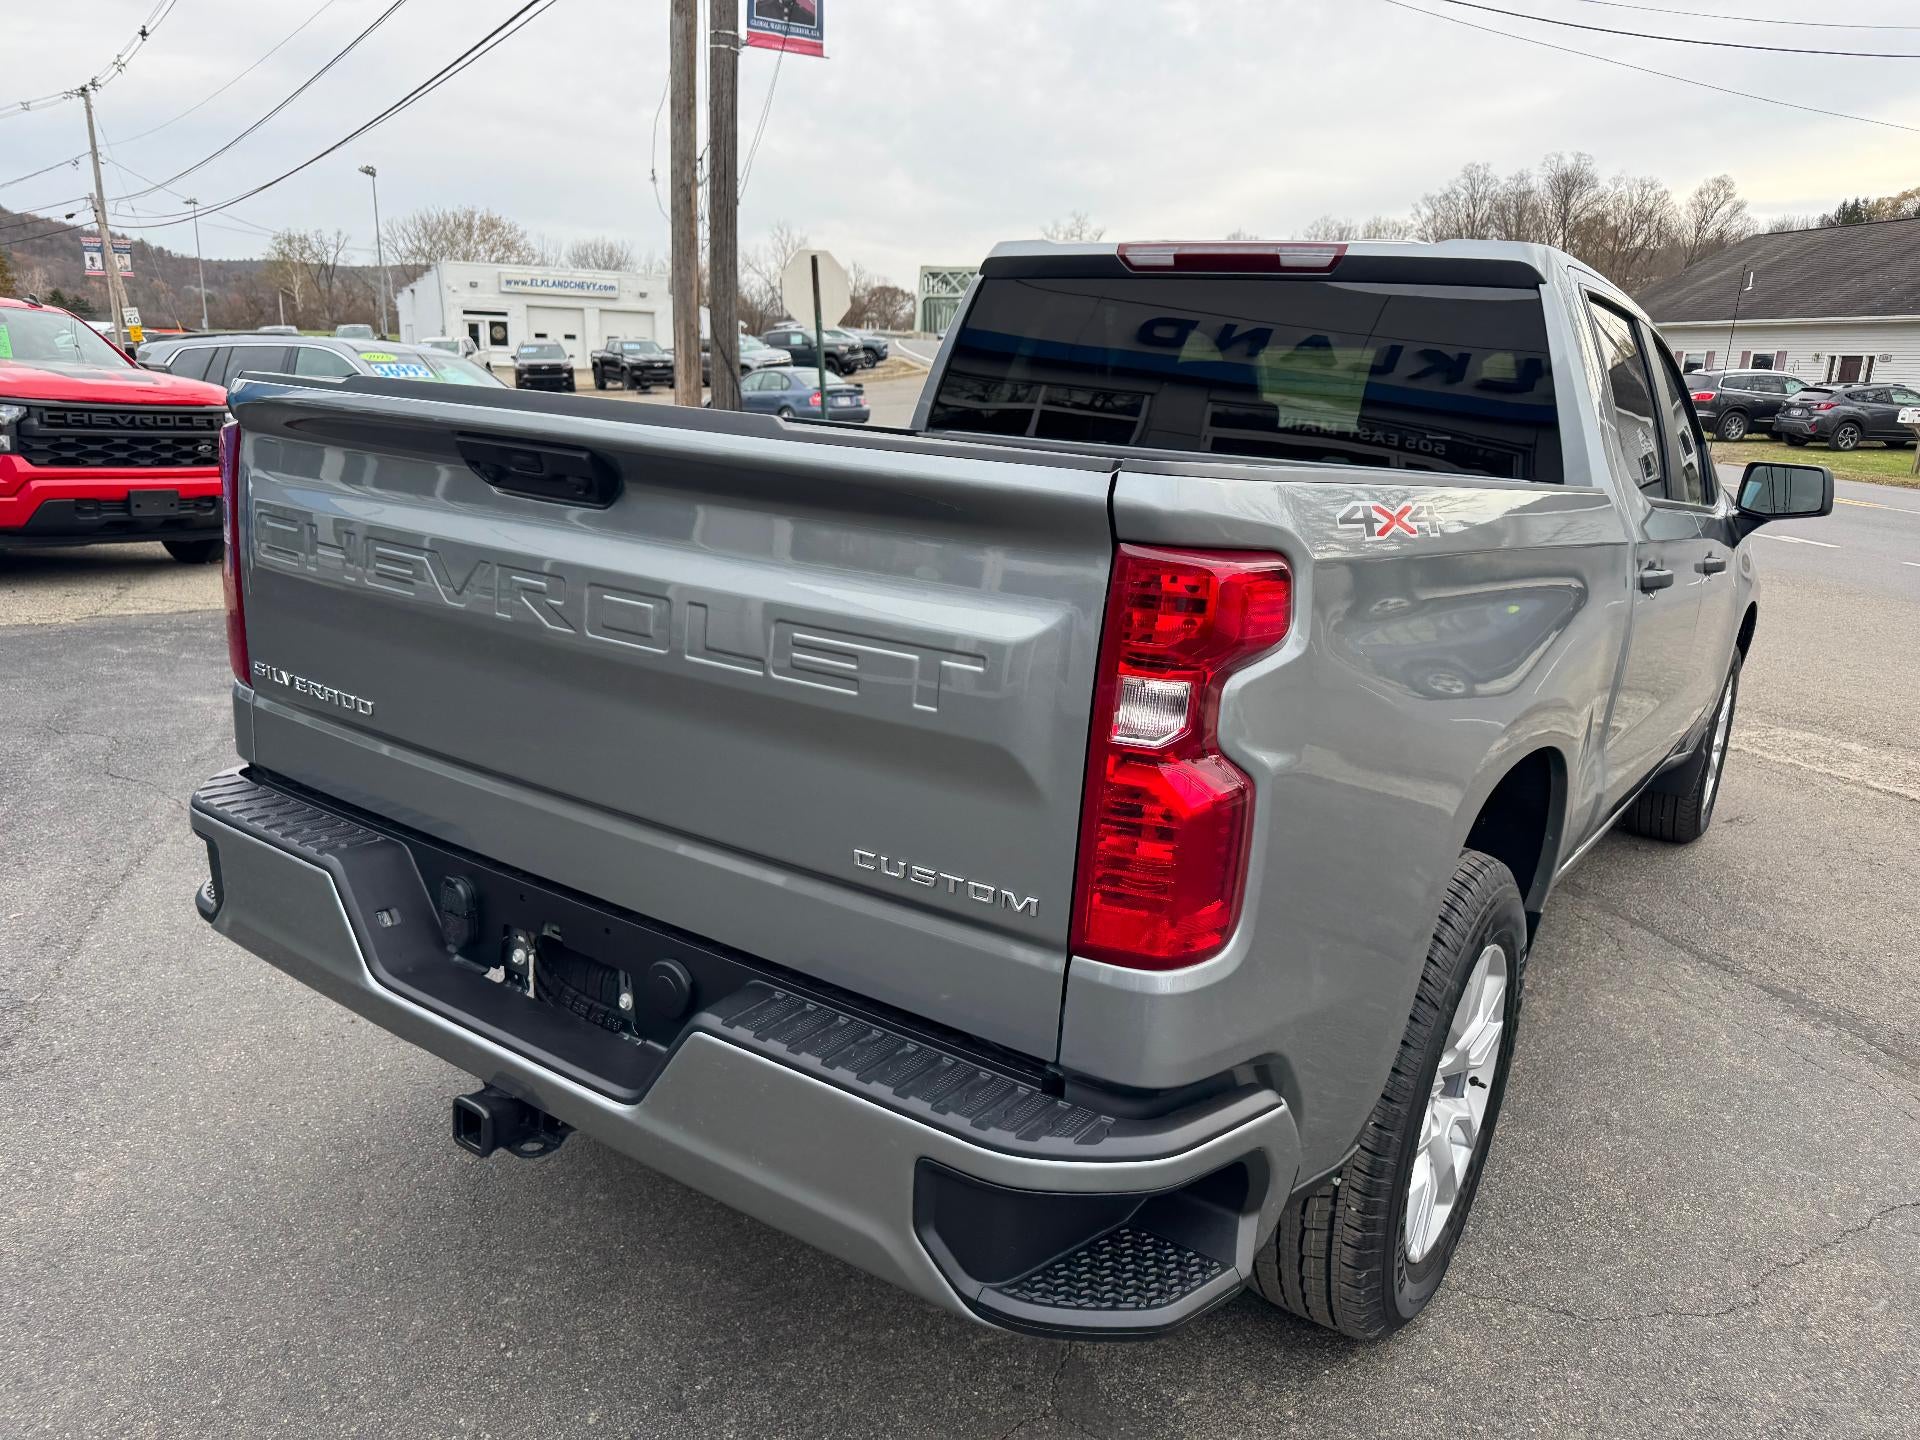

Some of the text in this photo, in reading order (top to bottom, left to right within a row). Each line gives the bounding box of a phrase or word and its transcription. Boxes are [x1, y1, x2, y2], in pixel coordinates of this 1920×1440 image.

[505, 278, 616, 292] www.ELKLANDCHEVY.com
[127, 316, 139, 324] 40
[374, 364, 429, 377] 36995
[254, 507, 988, 712] CHEVROLET
[253, 661, 374, 716] SILVERADO
[853, 848, 1040, 918] CUSTOM
